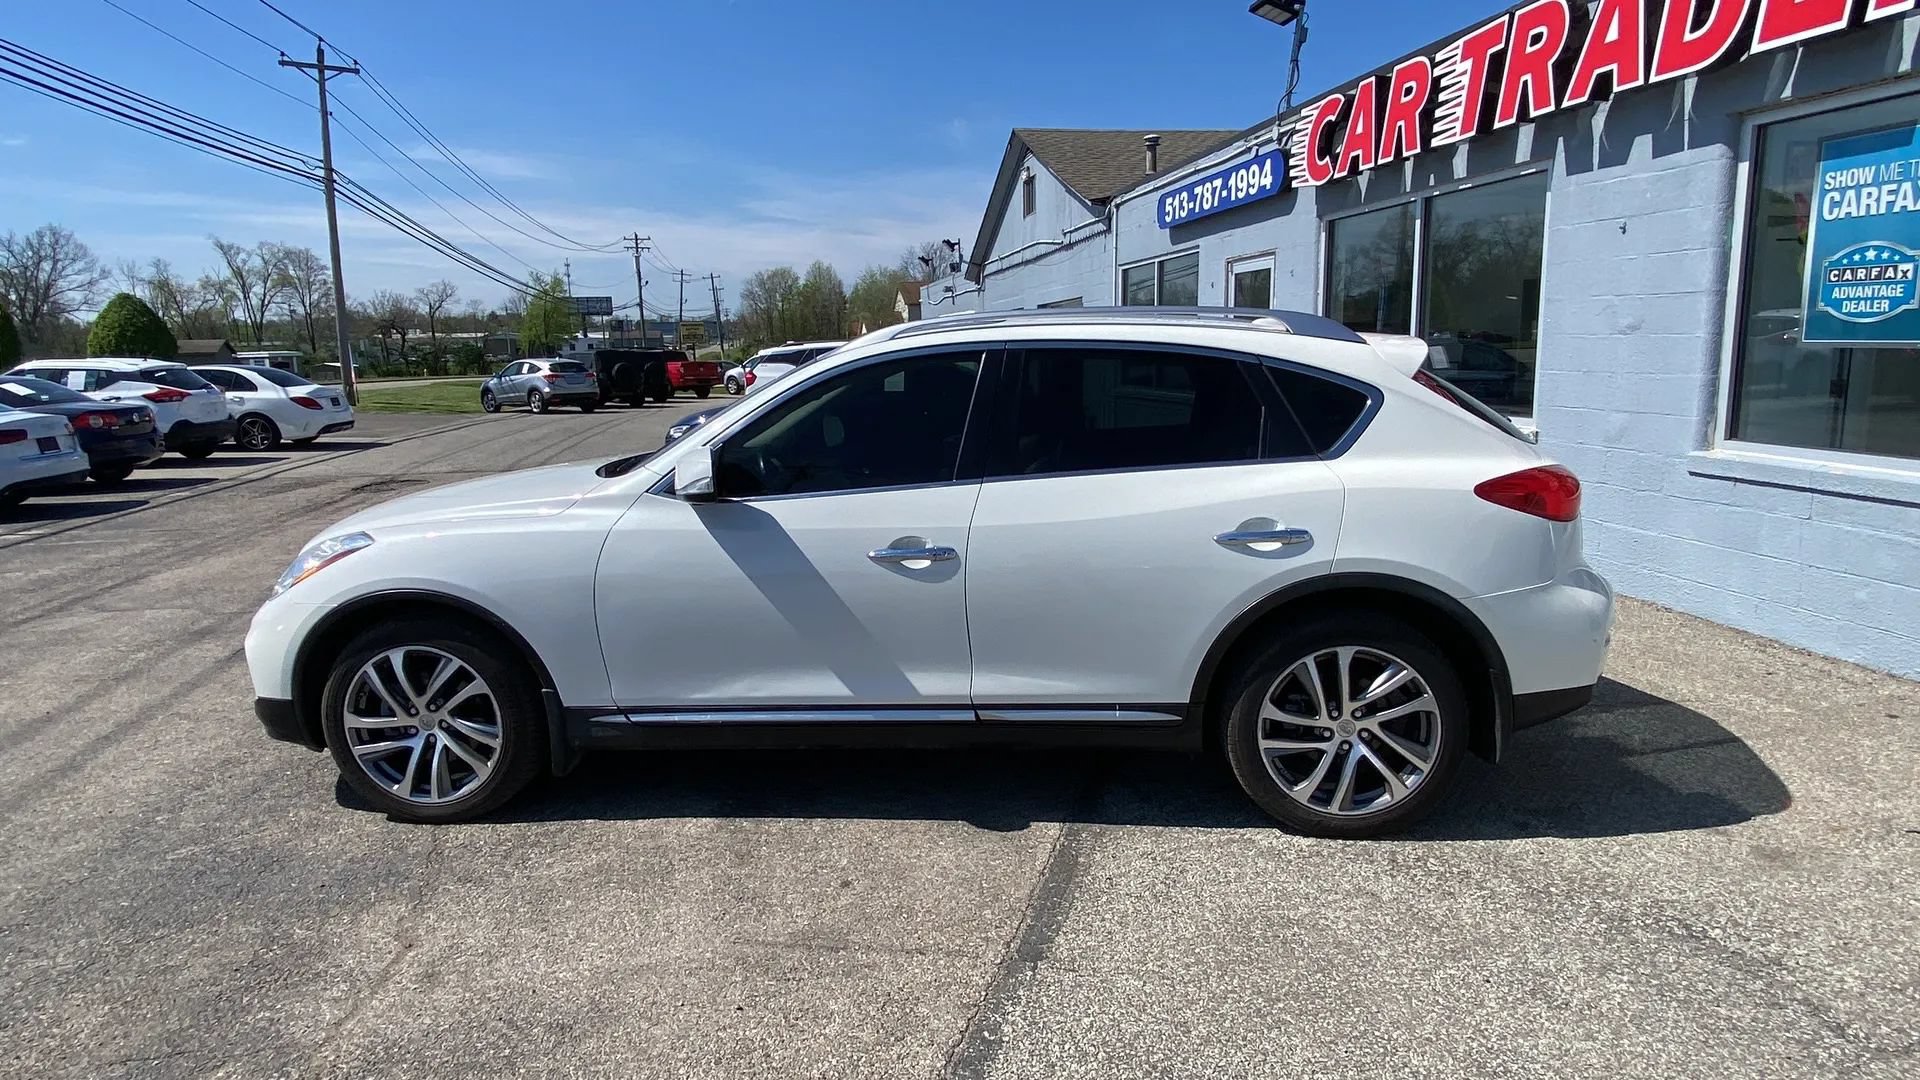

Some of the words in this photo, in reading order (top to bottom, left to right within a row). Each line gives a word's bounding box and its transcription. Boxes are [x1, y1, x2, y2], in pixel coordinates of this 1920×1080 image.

[1290, 56, 1431, 187] CAR
[1432, 0, 1915, 147] TRAD
[1824, 165, 1876, 190] SHOW
[1880, 161, 1905, 182] ME
[1908, 158, 1920, 178] T
[1165, 158, 1272, 222] 513-787-1994
[1828, 265, 1911, 282] CARFAX
[1832, 284, 1905, 299] ADVANTAGE
[1842, 299, 1889, 313] DEALER
